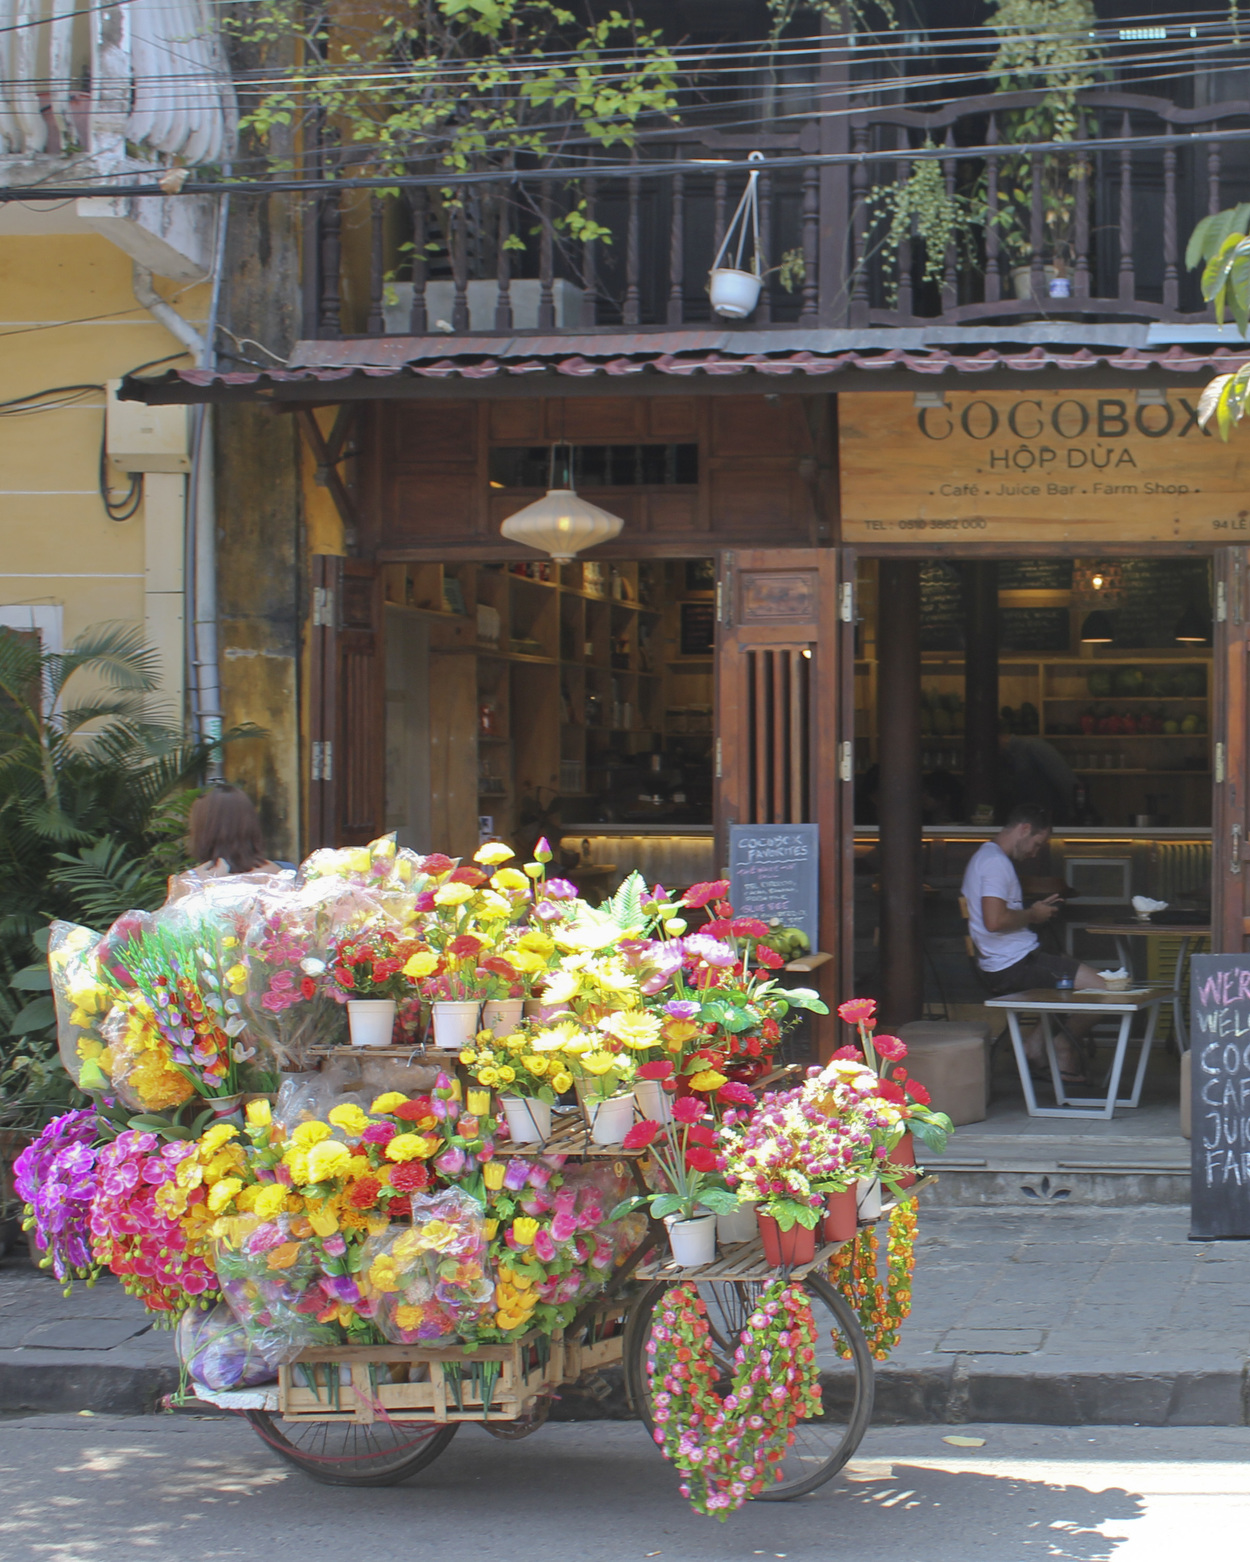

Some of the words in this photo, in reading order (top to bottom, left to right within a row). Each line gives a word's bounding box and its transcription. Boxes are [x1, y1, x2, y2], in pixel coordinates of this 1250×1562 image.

[917, 398, 1212, 440] COCOBOX
[990, 444, 1056, 473] HỘP
[1067, 443, 1137, 468] DỪA
[940, 482, 979, 497] Café
[996, 482, 1041, 496] Juice
[1046, 482, 1076, 496] Bar
[1092, 482, 1138, 495] Farm
[1143, 481, 1189, 496] Shop
[961, 519, 987, 530] 000
[1212, 520, 1228, 530] 94
[748, 845, 808, 860] FAVORITES
